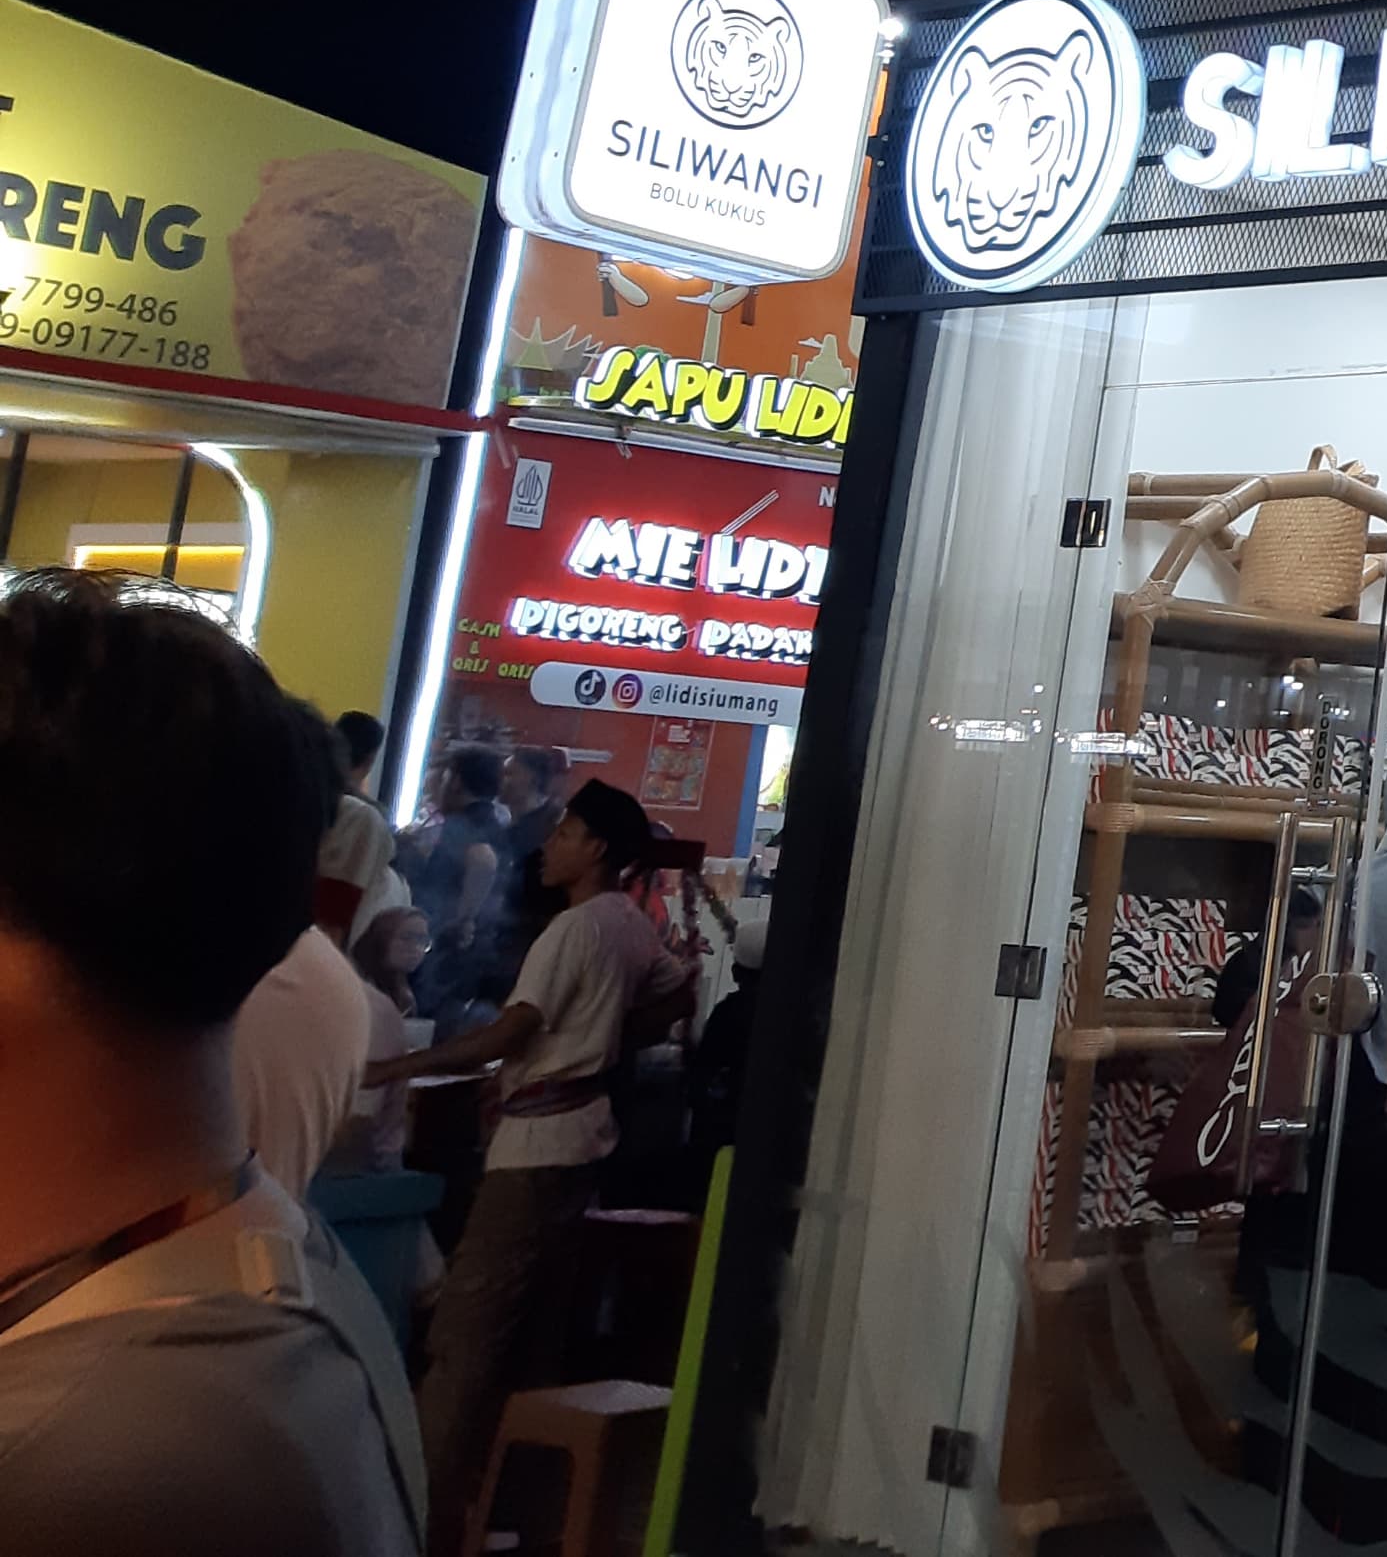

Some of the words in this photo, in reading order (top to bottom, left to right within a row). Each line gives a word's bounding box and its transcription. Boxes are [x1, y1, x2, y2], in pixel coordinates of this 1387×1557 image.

[607, 119, 823, 208] SILIWANGI
[650, 182, 699, 209] BOLU
[704, 196, 766, 226] KUKUS
[576, 346, 749, 431] SAPU
[567, 516, 698, 589] MIE
[510, 596, 687, 651] DIGORENG
[649, 683, 779, 717] @lidisiumang
[1313, 700, 1332, 789] DORONG
